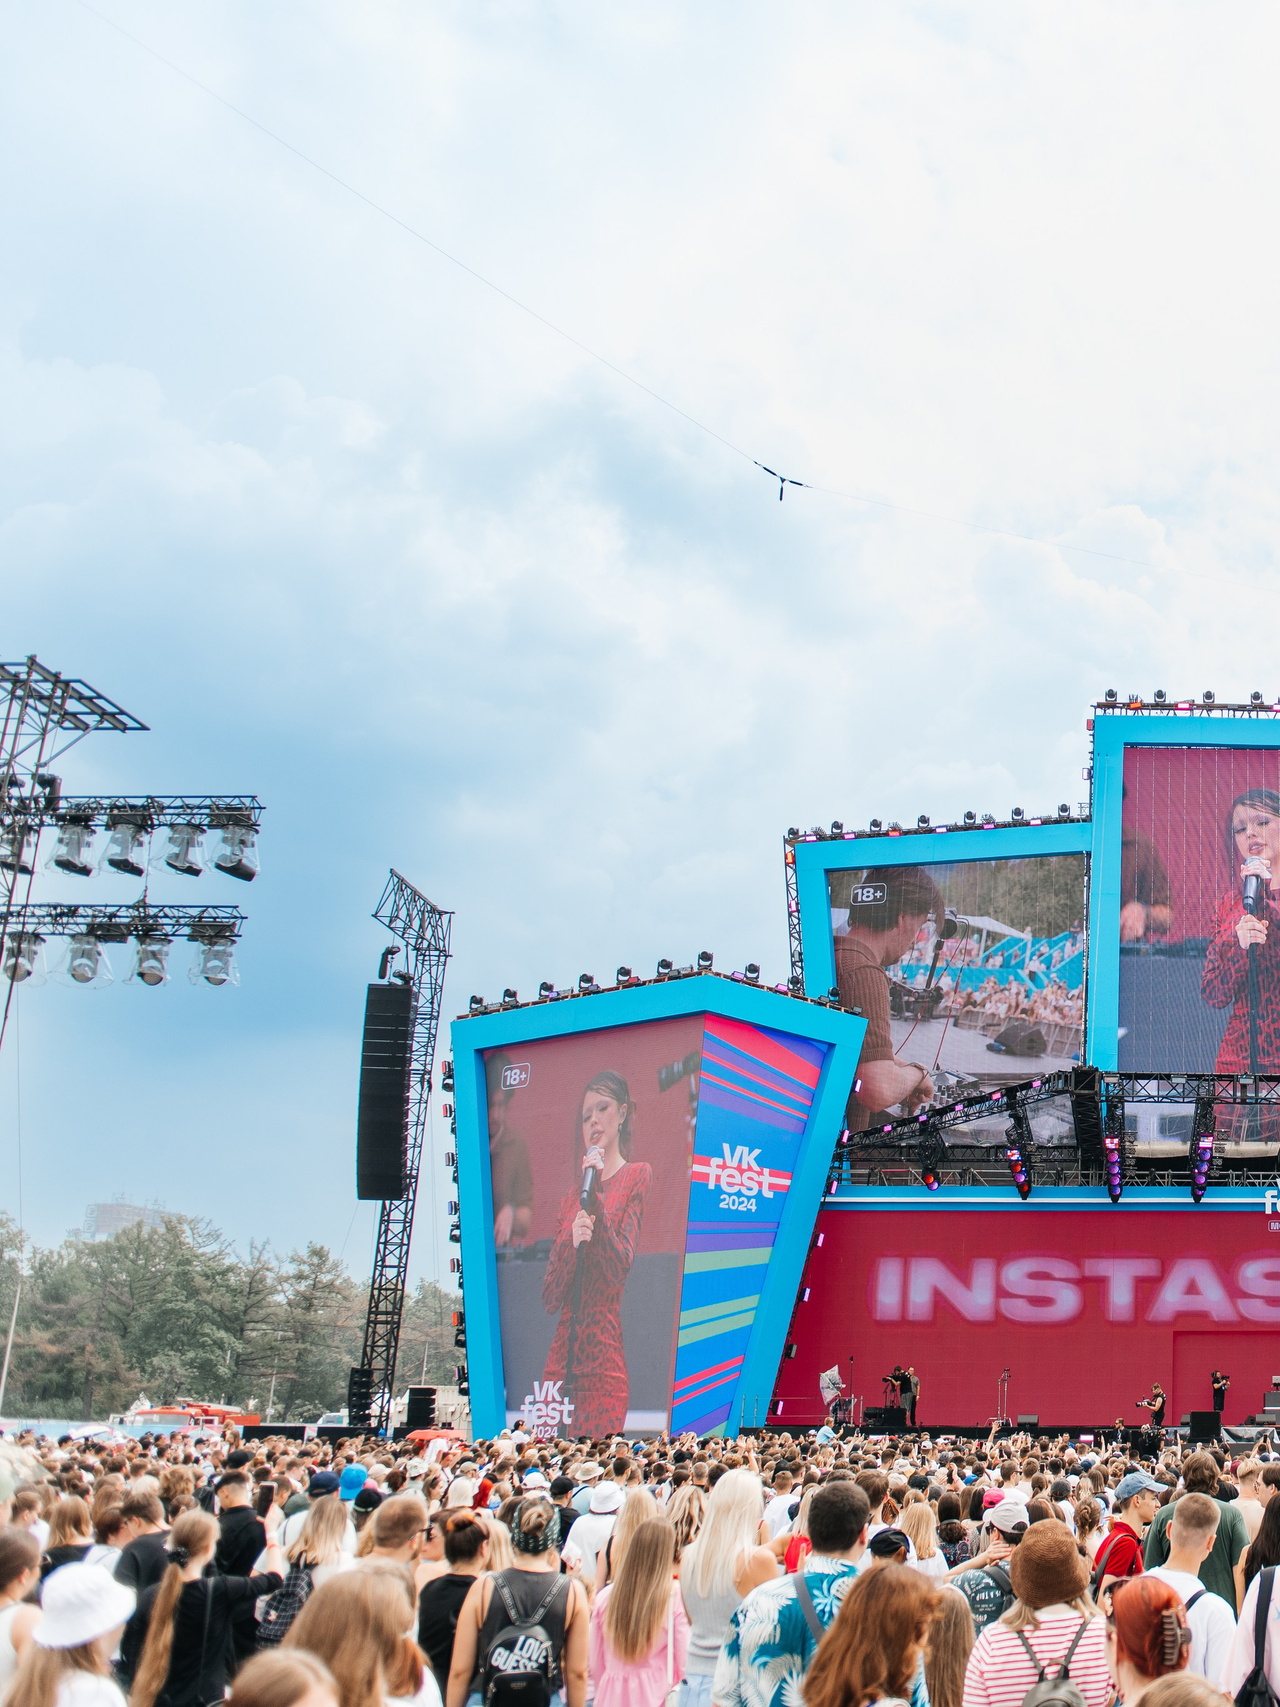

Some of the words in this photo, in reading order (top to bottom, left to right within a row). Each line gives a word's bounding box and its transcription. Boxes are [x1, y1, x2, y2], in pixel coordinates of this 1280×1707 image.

[854, 887, 883, 902] 18+
[504, 1068, 527, 1086] 18+
[722, 1142, 763, 1172] VK
[707, 1156, 775, 1199] fest
[719, 1194, 757, 1213] 2024
[533, 1380, 563, 1402] VK
[520, 1394, 575, 1425] fest
[513, 1634, 549, 1664] LOVE
